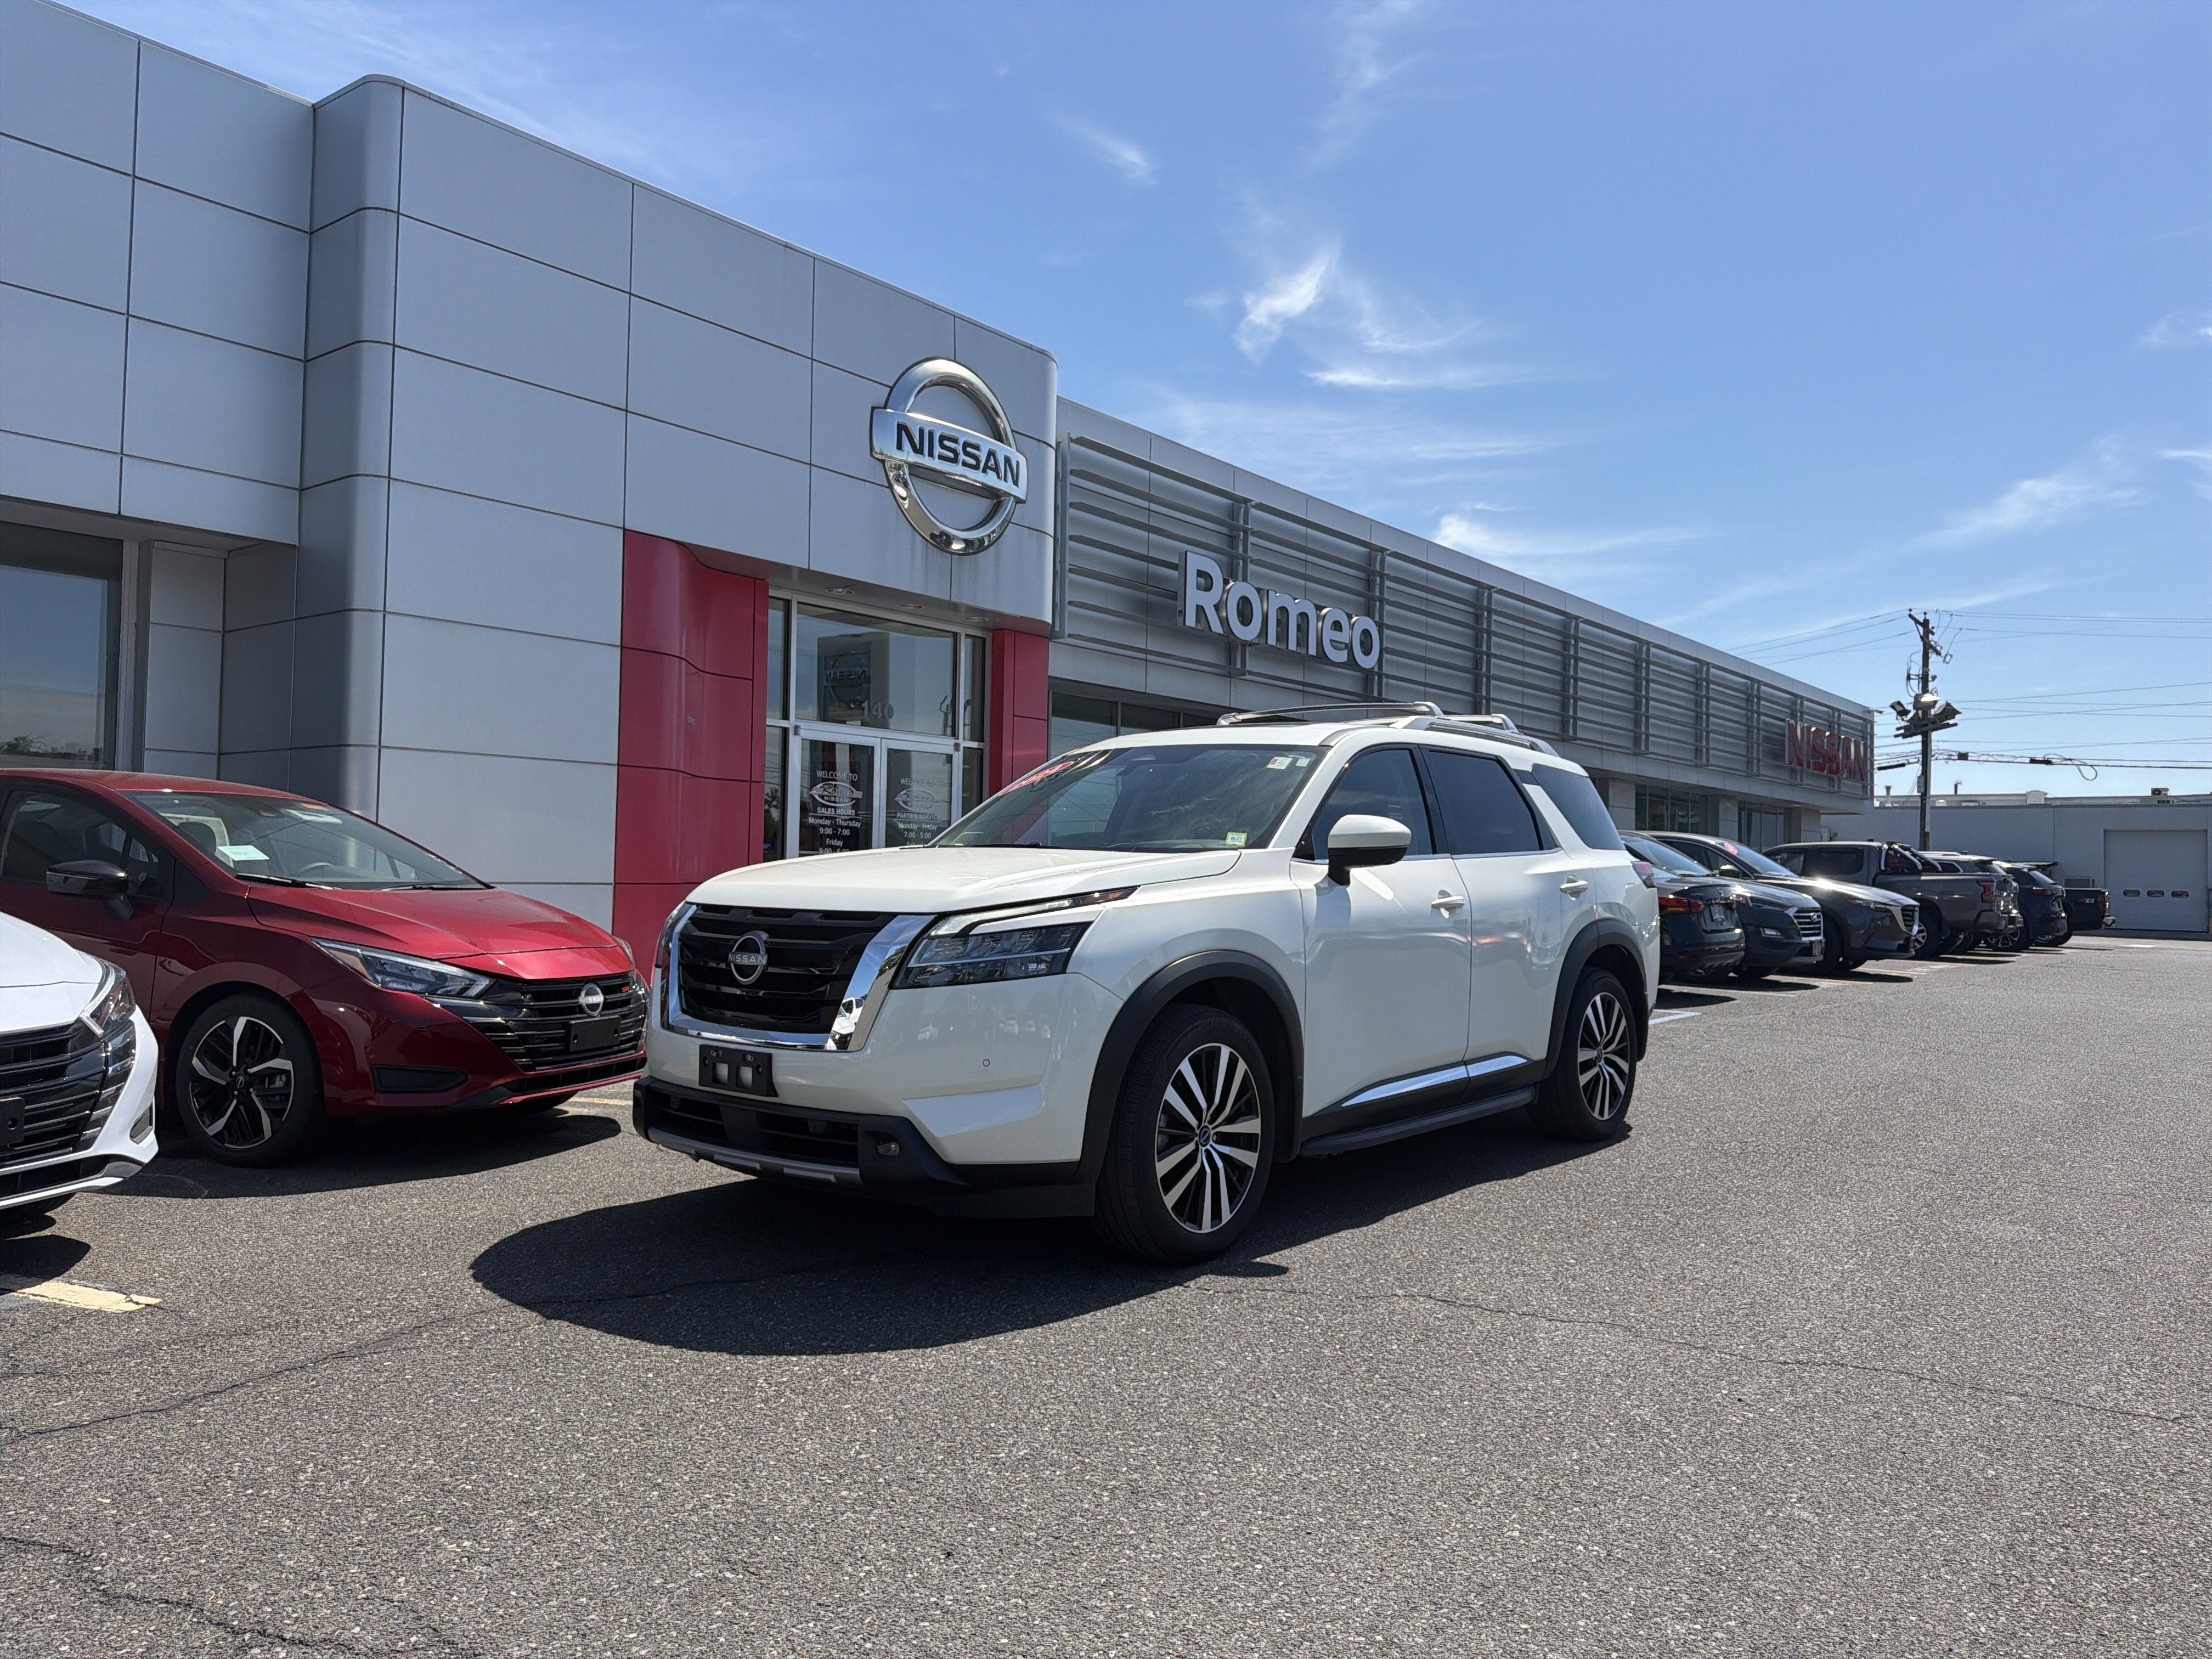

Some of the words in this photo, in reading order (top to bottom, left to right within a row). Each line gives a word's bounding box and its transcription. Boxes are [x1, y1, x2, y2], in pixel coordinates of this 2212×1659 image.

[896, 421, 1020, 488] NISSAN
[1181, 550, 1380, 669] Romeo
[861, 700, 895, 720] 140
[1785, 718, 1867, 782] NISSAN
[816, 770, 848, 780] WELCOME
[849, 773, 858, 781] TO
[836, 808, 855, 816] HOURS
[809, 817, 831, 826] Monday
[836, 819, 861, 828] Thursday
[898, 822, 918, 831] Monday
[826, 838, 844, 847] Friday
[728, 953, 766, 963] NISSAN
